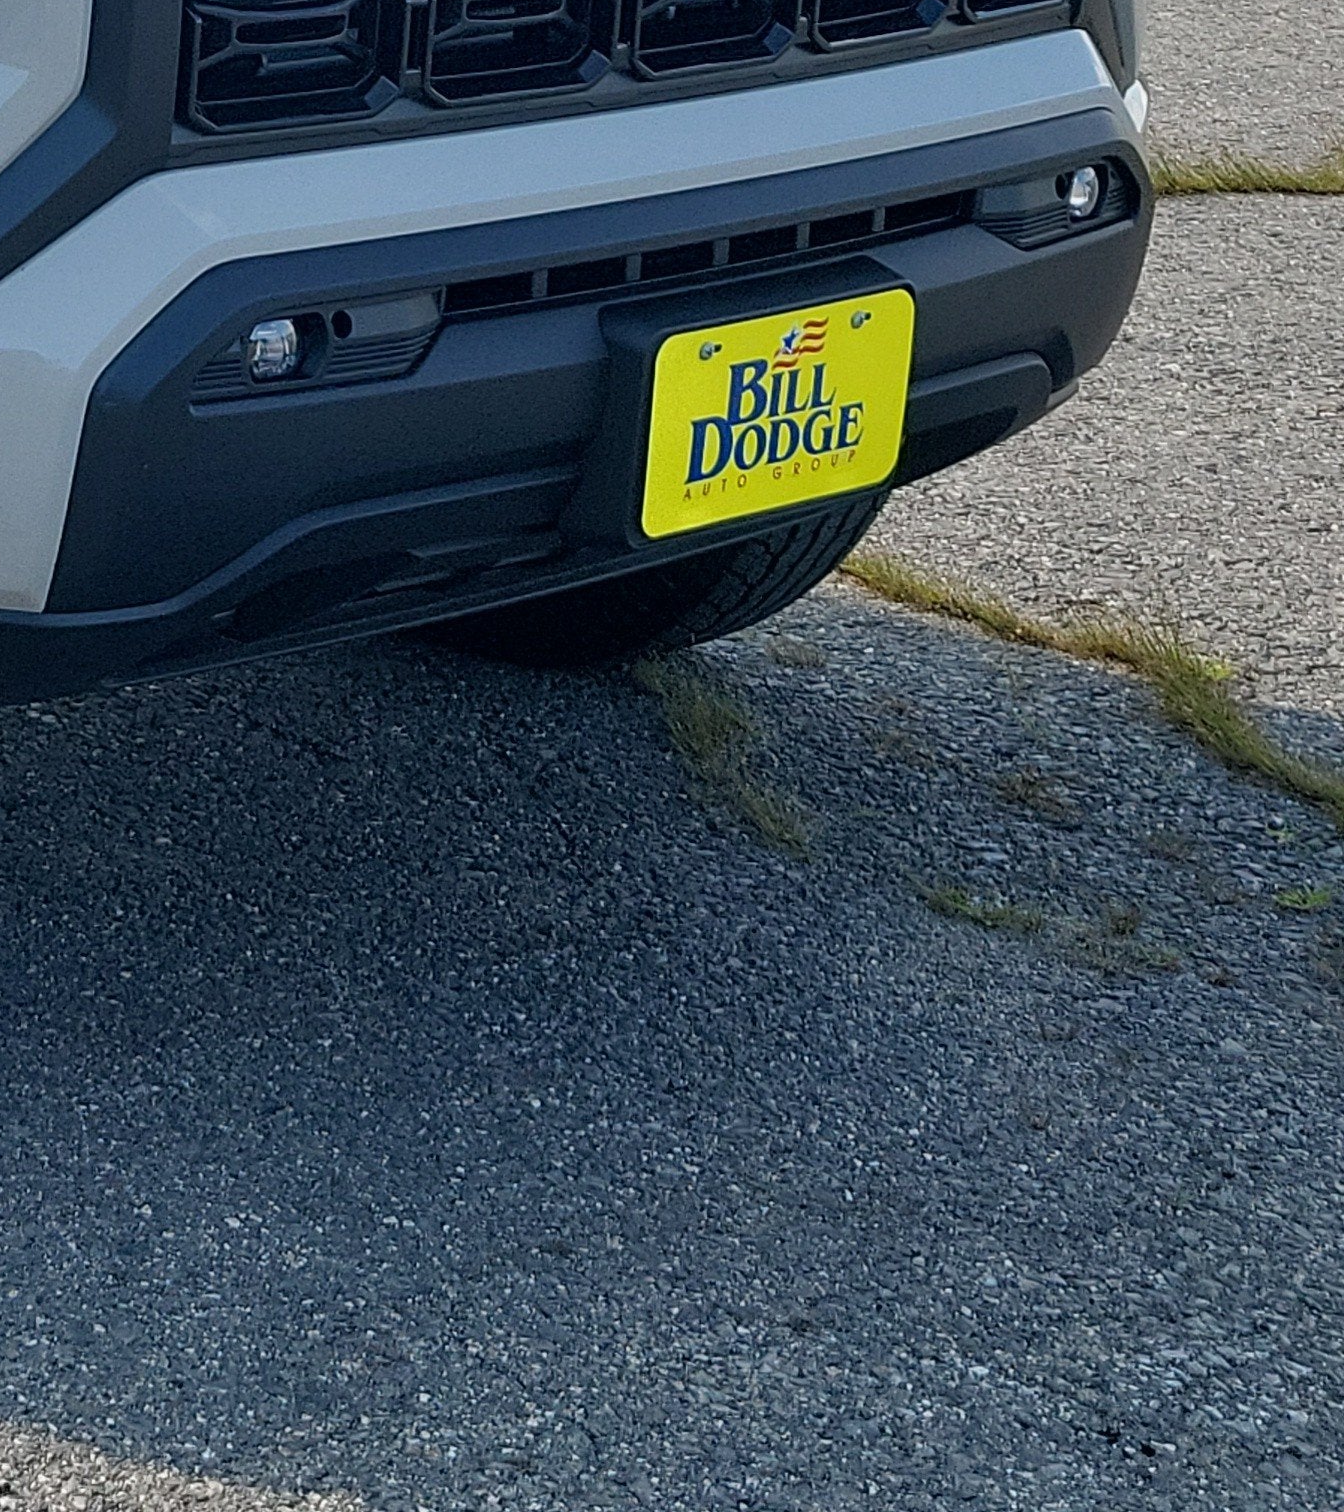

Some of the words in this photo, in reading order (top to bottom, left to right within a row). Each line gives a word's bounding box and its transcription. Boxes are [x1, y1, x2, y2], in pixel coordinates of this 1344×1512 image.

[726, 358, 837, 425] BILL
[683, 474, 748, 501] AUTO
[771, 450, 856, 480] GROUP
[685, 402, 864, 485] DODGE
